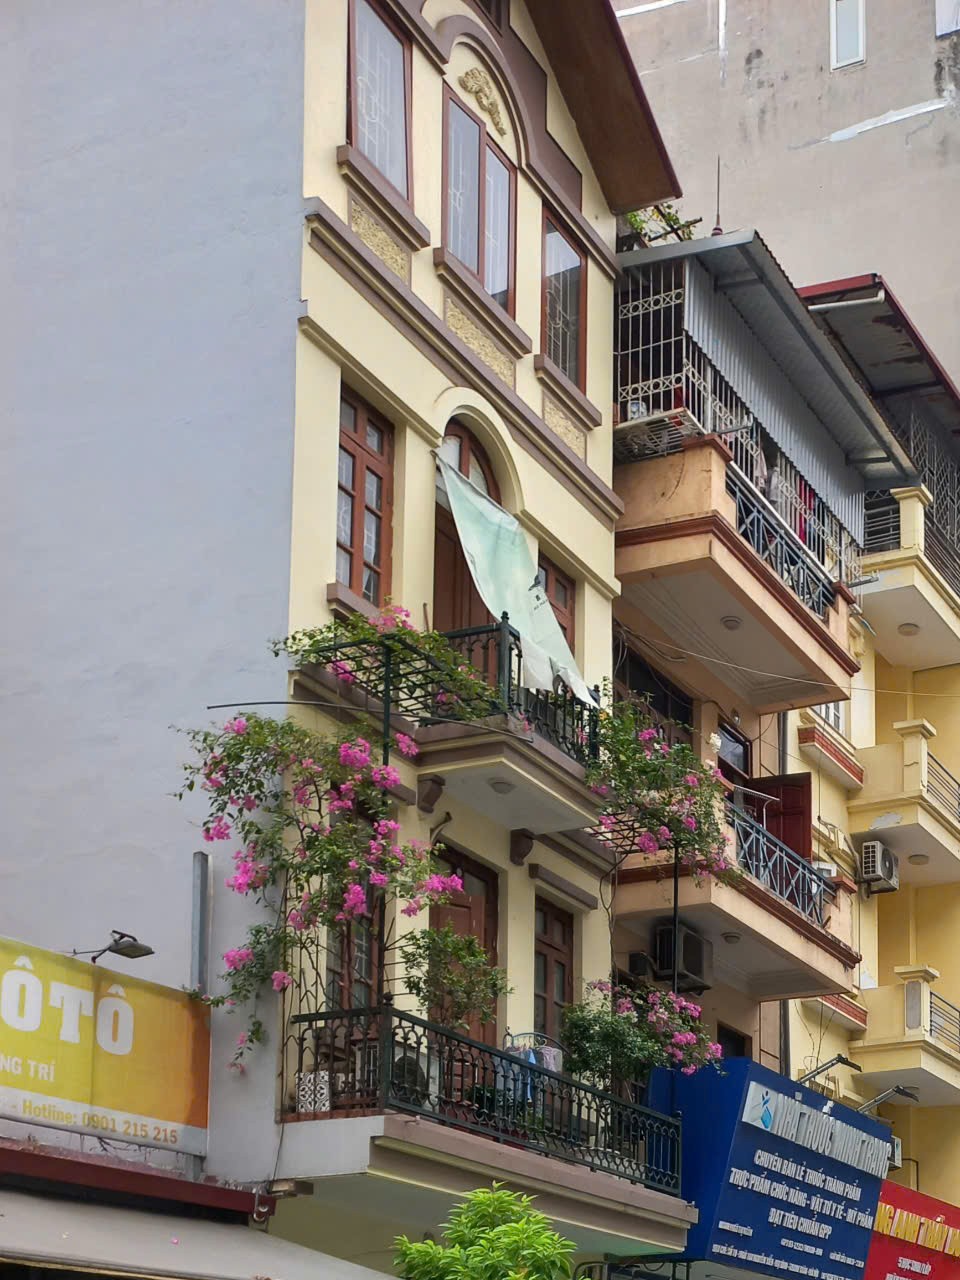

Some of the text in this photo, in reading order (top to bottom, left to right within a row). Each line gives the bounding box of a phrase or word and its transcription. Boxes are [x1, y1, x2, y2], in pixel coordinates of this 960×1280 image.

[27, 1058, 56, 1082] TRÍ
[22, 1099, 77, 1125] Hotline:
[82, 1111, 118, 1133] 0901
[123, 1119, 149, 1139] 215
[153, 1126, 178, 1145] 215
[795, 1100, 836, 1156] THUỐC
[729, 1167, 750, 1190] THỰC
[748, 1171, 771, 1196] PHẨM
[754, 1150, 783, 1172] CHUYÊN
[804, 1167, 826, 1189] THUỐC
